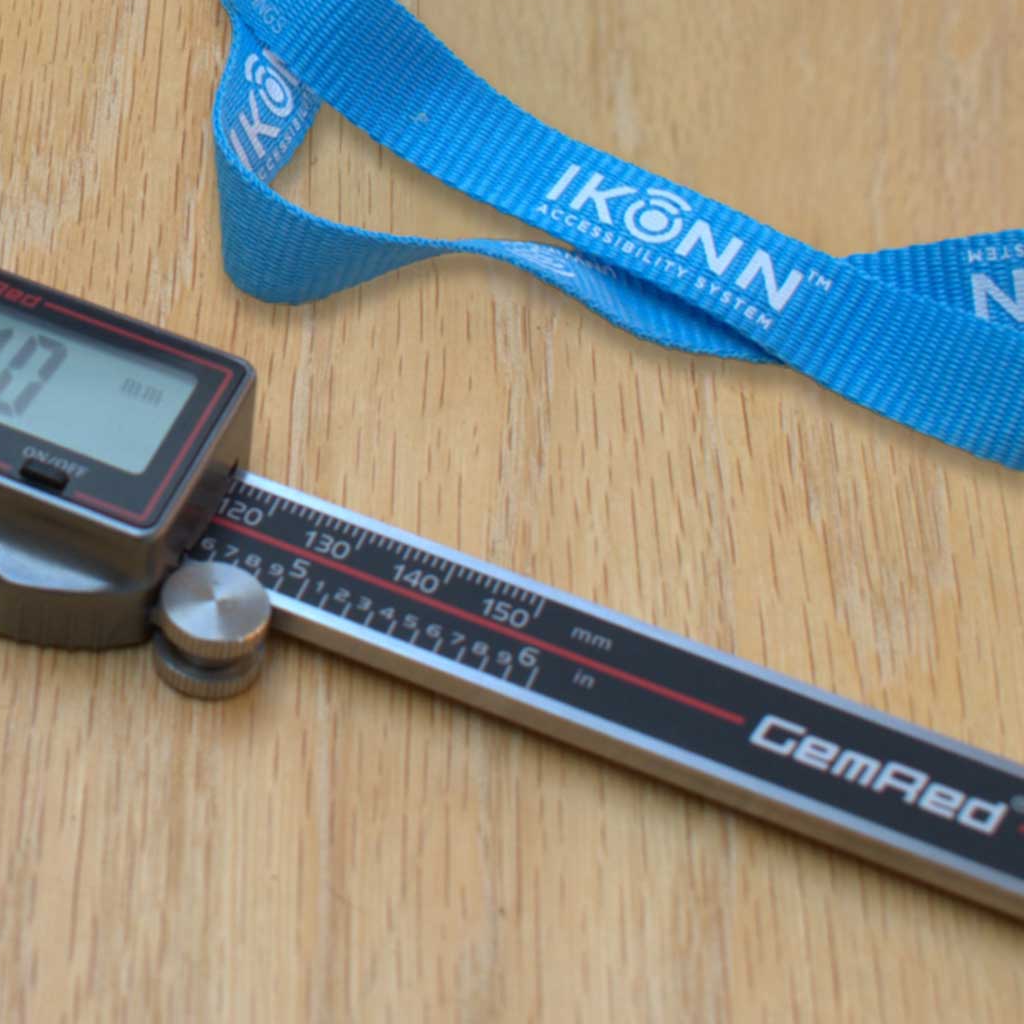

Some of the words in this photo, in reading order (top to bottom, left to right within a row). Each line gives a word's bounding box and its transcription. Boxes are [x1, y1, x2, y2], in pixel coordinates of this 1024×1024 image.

[230, 48, 300, 170] IKO
[535, 203, 688, 278] ACCESSIBILITY
[694, 275, 774, 331] SYSTEM
[546, 163, 804, 312] IKONN
[200, 536, 217, 551] 6
[223, 543, 239, 558] 7
[244, 553, 262, 568] 8
[268, 562, 285, 576] 9
[287, 557, 312, 579] 5
[316, 579, 326, 593] 1
[333, 587, 351, 603] 2
[356, 596, 373, 611] 3
[378, 606, 396, 620] 4
[517, 646, 541, 668] 6
[572, 667, 596, 690] in
[218, 496, 264, 527] 120
[304, 530, 352, 560] 130
[393, 563, 440, 594] 140
[482, 597, 530, 629] 150
[570, 625, 614, 652] mm
[748, 713, 1009, 836] GemRed
